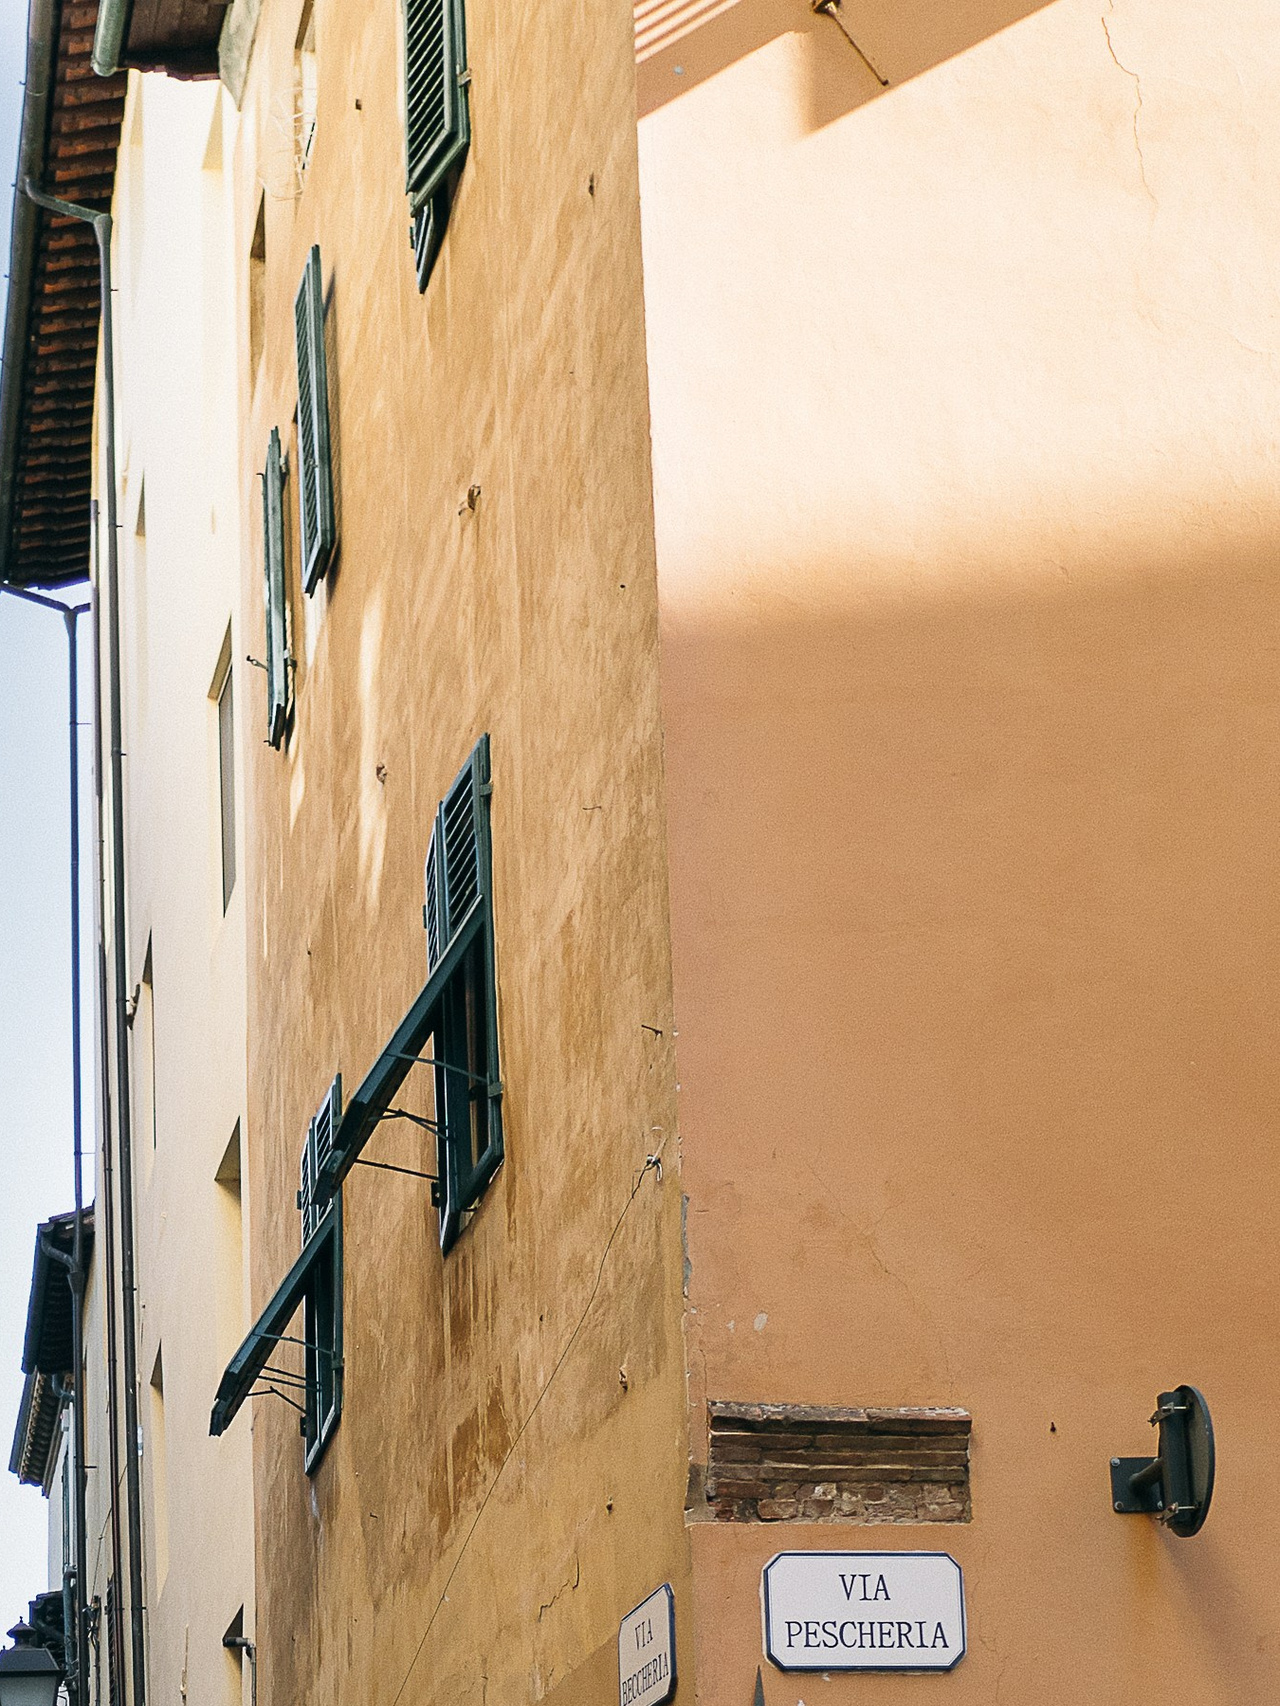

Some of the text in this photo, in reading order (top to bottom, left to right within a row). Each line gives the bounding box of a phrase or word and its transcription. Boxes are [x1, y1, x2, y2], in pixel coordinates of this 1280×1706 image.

[838, 1573, 891, 1601] VIA
[634, 1618, 654, 1651] VIA
[784, 1620, 950, 1649] PESCHERIA
